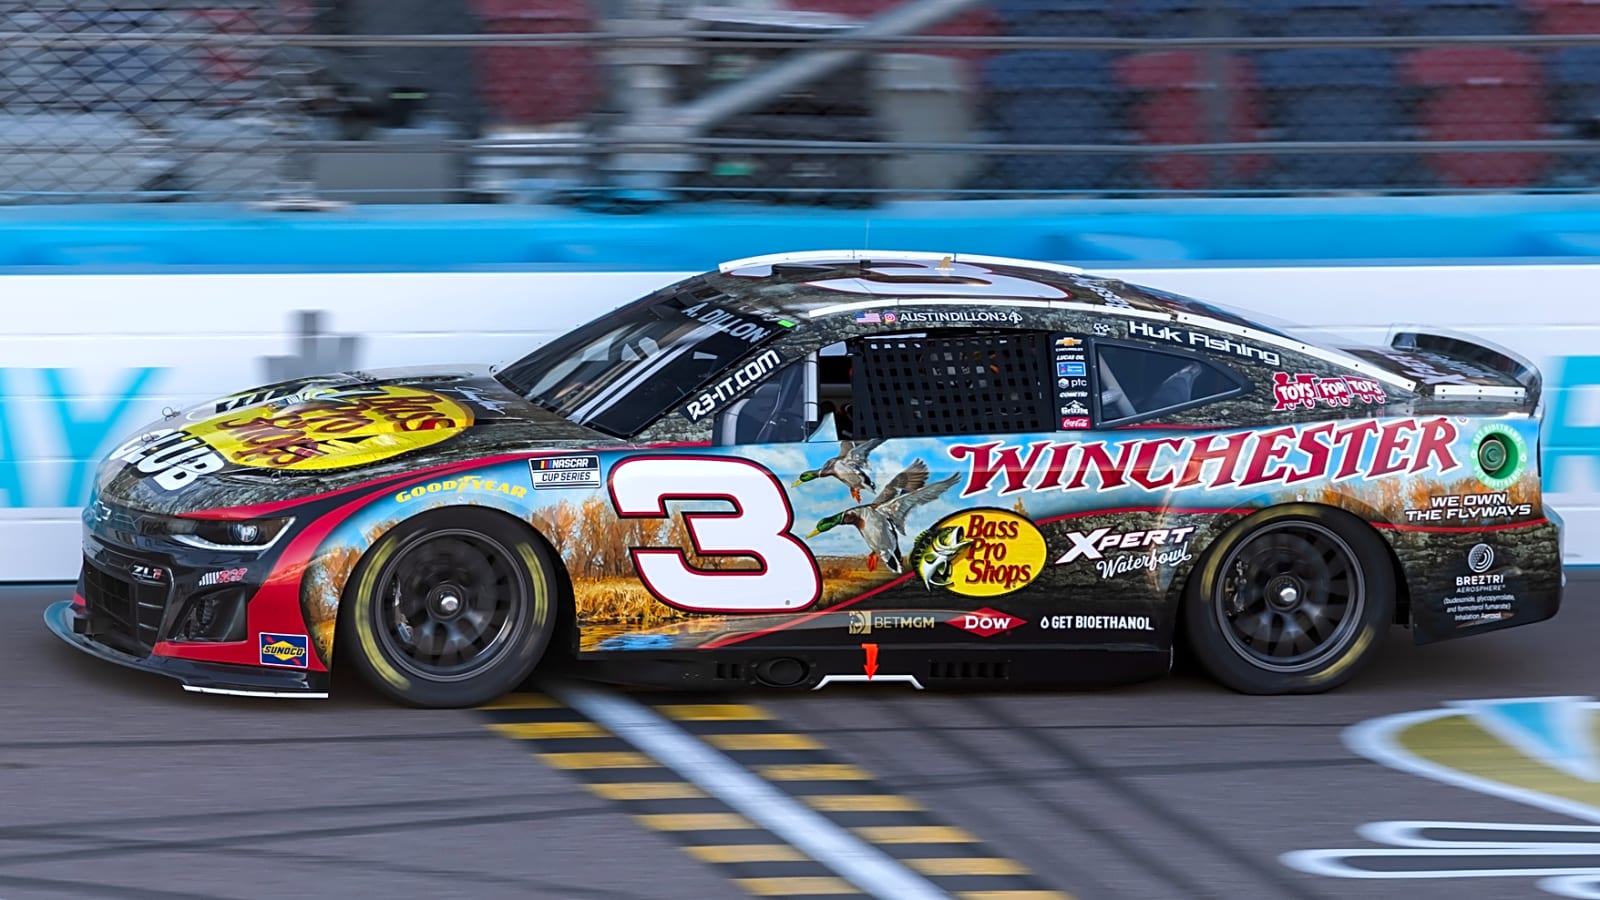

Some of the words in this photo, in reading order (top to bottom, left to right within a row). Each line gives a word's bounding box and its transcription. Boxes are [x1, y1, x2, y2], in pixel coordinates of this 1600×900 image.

[680, 302, 709, 319] A.
[702, 308, 771, 343] DILLON
[900, 311, 1008, 323] AUSTINDILLON3
[1129, 321, 1183, 342] Huk
[1188, 331, 1281, 366] Fishing
[686, 349, 781, 421] R3-IT.COM
[1278, 382, 1315, 401] TOYS
[1320, 381, 1348, 397] FOR
[1349, 379, 1382, 394] TOTS
[552, 458, 589, 468] NASCAR
[949, 415, 1461, 496] WINCHESTER
[542, 473, 559, 482] CUP
[561, 472, 591, 481] SERIES
[395, 475, 528, 503] GOODYEAR
[1431, 496, 1460, 507] WE
[1463, 494, 1507, 506] OWN
[1405, 510, 1442, 521] THE
[1446, 505, 1532, 519] FLYWAYS
[606, 454, 824, 614] 3
[966, 515, 1019, 539] Bass
[966, 538, 1007, 561] Pro
[1096, 542, 1192, 579] Waterfowl
[965, 560, 1031, 588] Shops
[1456, 575, 1504, 586] BREZTRI
[875, 616, 935, 629] BETMGM
[1051, 616, 1072, 629] GET
[1076, 616, 1154, 630] BIOETHANOL
[264, 646, 304, 656] SUNOCO
